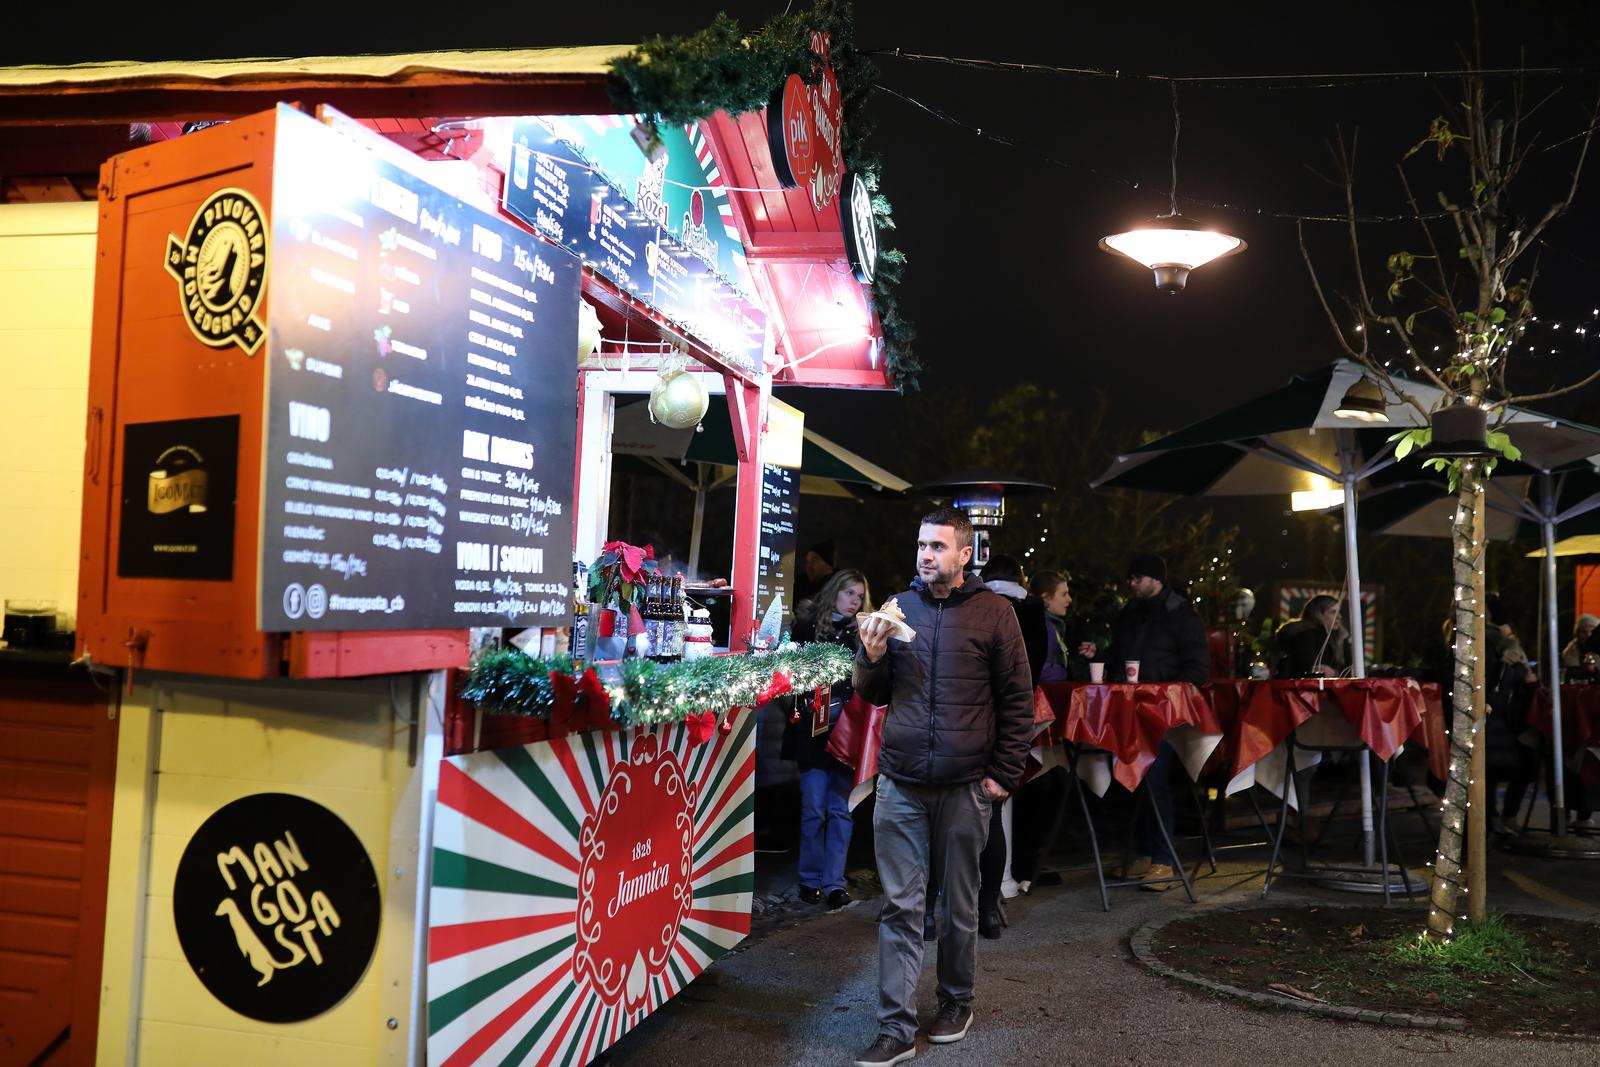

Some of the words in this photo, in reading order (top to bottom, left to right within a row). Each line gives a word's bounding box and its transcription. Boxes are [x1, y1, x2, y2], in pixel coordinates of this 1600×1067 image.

[791, 111, 808, 155] pik
[204, 198, 264, 268] PIVOVARA
[185, 245, 252, 335] MEDVEDGRAD
[490, 514, 509, 527] COLA
[454, 580, 475, 591] VODA
[524, 582, 545, 593] TONIC
[217, 830, 309, 890] MAN
[631, 838, 652, 862] 1828
[607, 860, 670, 918] Jamnica
